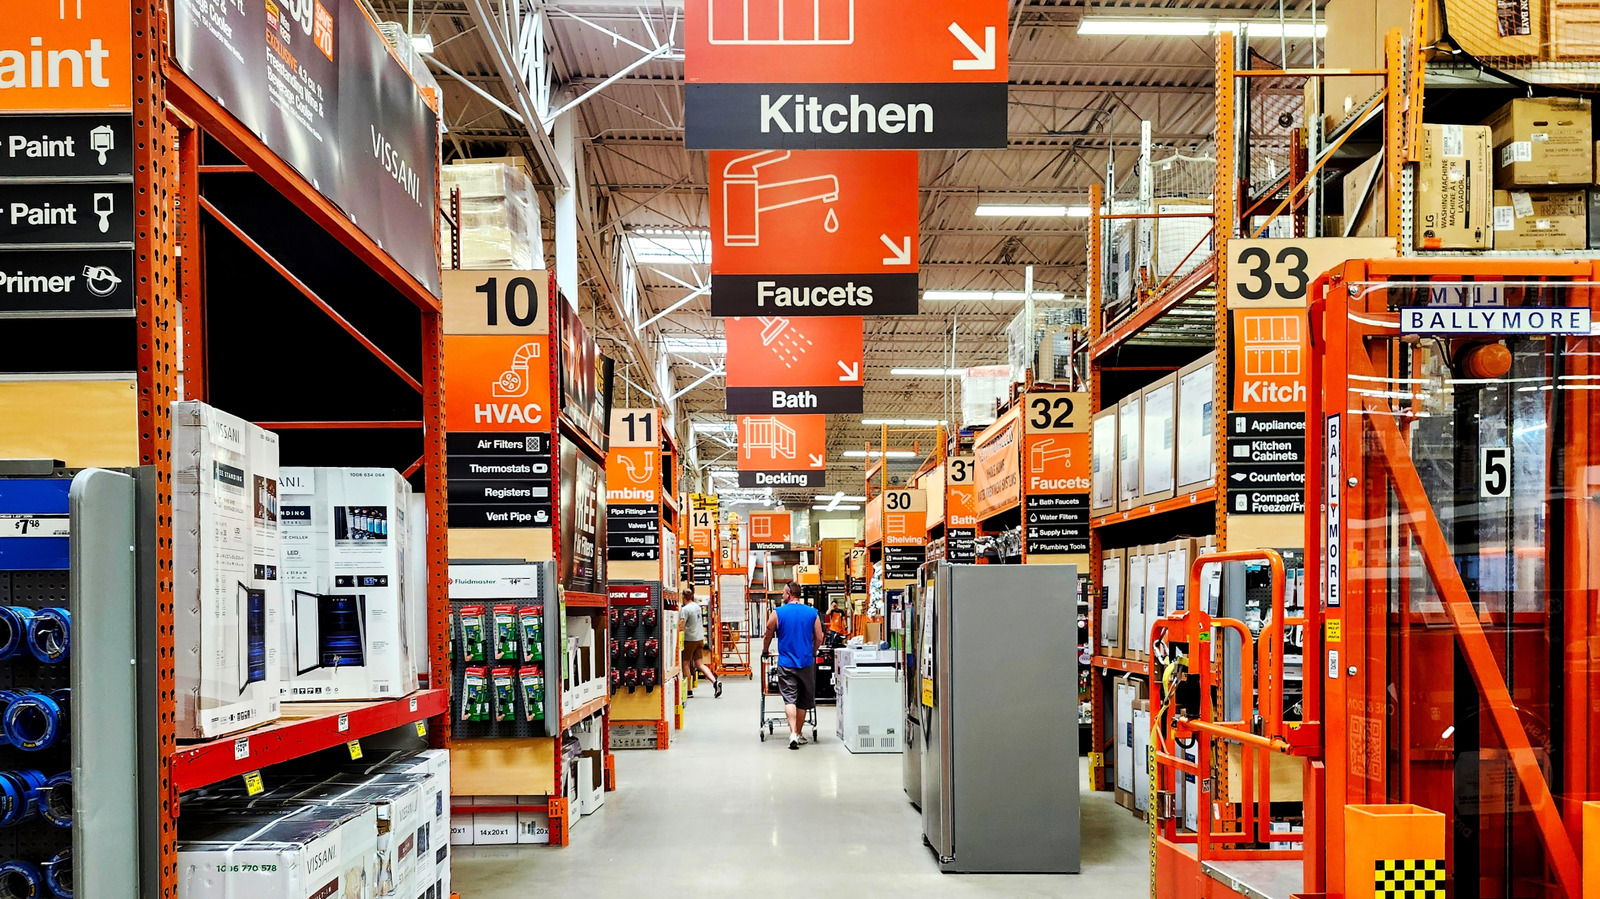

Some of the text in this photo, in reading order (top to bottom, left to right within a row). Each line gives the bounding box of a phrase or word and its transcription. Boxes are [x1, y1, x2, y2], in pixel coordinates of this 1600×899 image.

[315, 3, 332, 34] SAVE
[315, 20, 332, 56] $70
[0, 37, 110, 88] aint
[266, 27, 298, 74] EXCLUSIVE
[298, 64, 307, 84] 4.3
[266, 46, 324, 118] Freestanding Wine &
[267, 64, 295, 104] Beverage
[295, 94, 313, 123] Cooler
[760, 94, 934, 133] Kitchen
[9, 135, 75, 158] Paint
[11, 203, 77, 226] Paint
[1425, 214, 1434, 228] LG
[0, 270, 75, 293] Primer
[1236, 246, 1310, 300] 33
[475, 277, 539, 327] 10
[757, 281, 874, 307] Faucets
[1411, 311, 1580, 329] BALLYMORE
[772, 391, 818, 408] Bath
[1242, 381, 1307, 402] Kitch
[474, 403, 542, 424] HVAC
[1031, 397, 1074, 429] 32
[622, 412, 652, 442] 11
[1251, 420, 1306, 432] Appliances
[477, 440, 524, 449] Air Filters
[1252, 441, 1292, 451] Kitchen
[1252, 451, 1298, 461] Cabinets
[469, 464, 530, 473] Thermostats
[951, 459, 975, 482] 31
[1485, 449, 1507, 495] 5
[279, 476, 305, 487] ANI.
[756, 472, 808, 486] Decking
[1031, 477, 1091, 490] Faucets
[1249, 472, 1305, 484] Countertop
[484, 488, 530, 498] Registers
[886, 492, 911, 510] 30
[1252, 492, 1299, 504] Compact
[486, 511, 532, 523] Vent Pipe
[611, 508, 647, 516] Pipe Fittings
[693, 512, 709, 527] 14
[1330, 424, 1338, 598] BALLYMORE
[951, 515, 977, 525] Bath
[624, 536, 645, 544] Tubing
[887, 536, 922, 545] Shelving
[1039, 529, 1060, 537] Supply
[852, 550, 865, 559] 27
[241, 864, 259, 872] 770
[261, 864, 277, 872] 578
